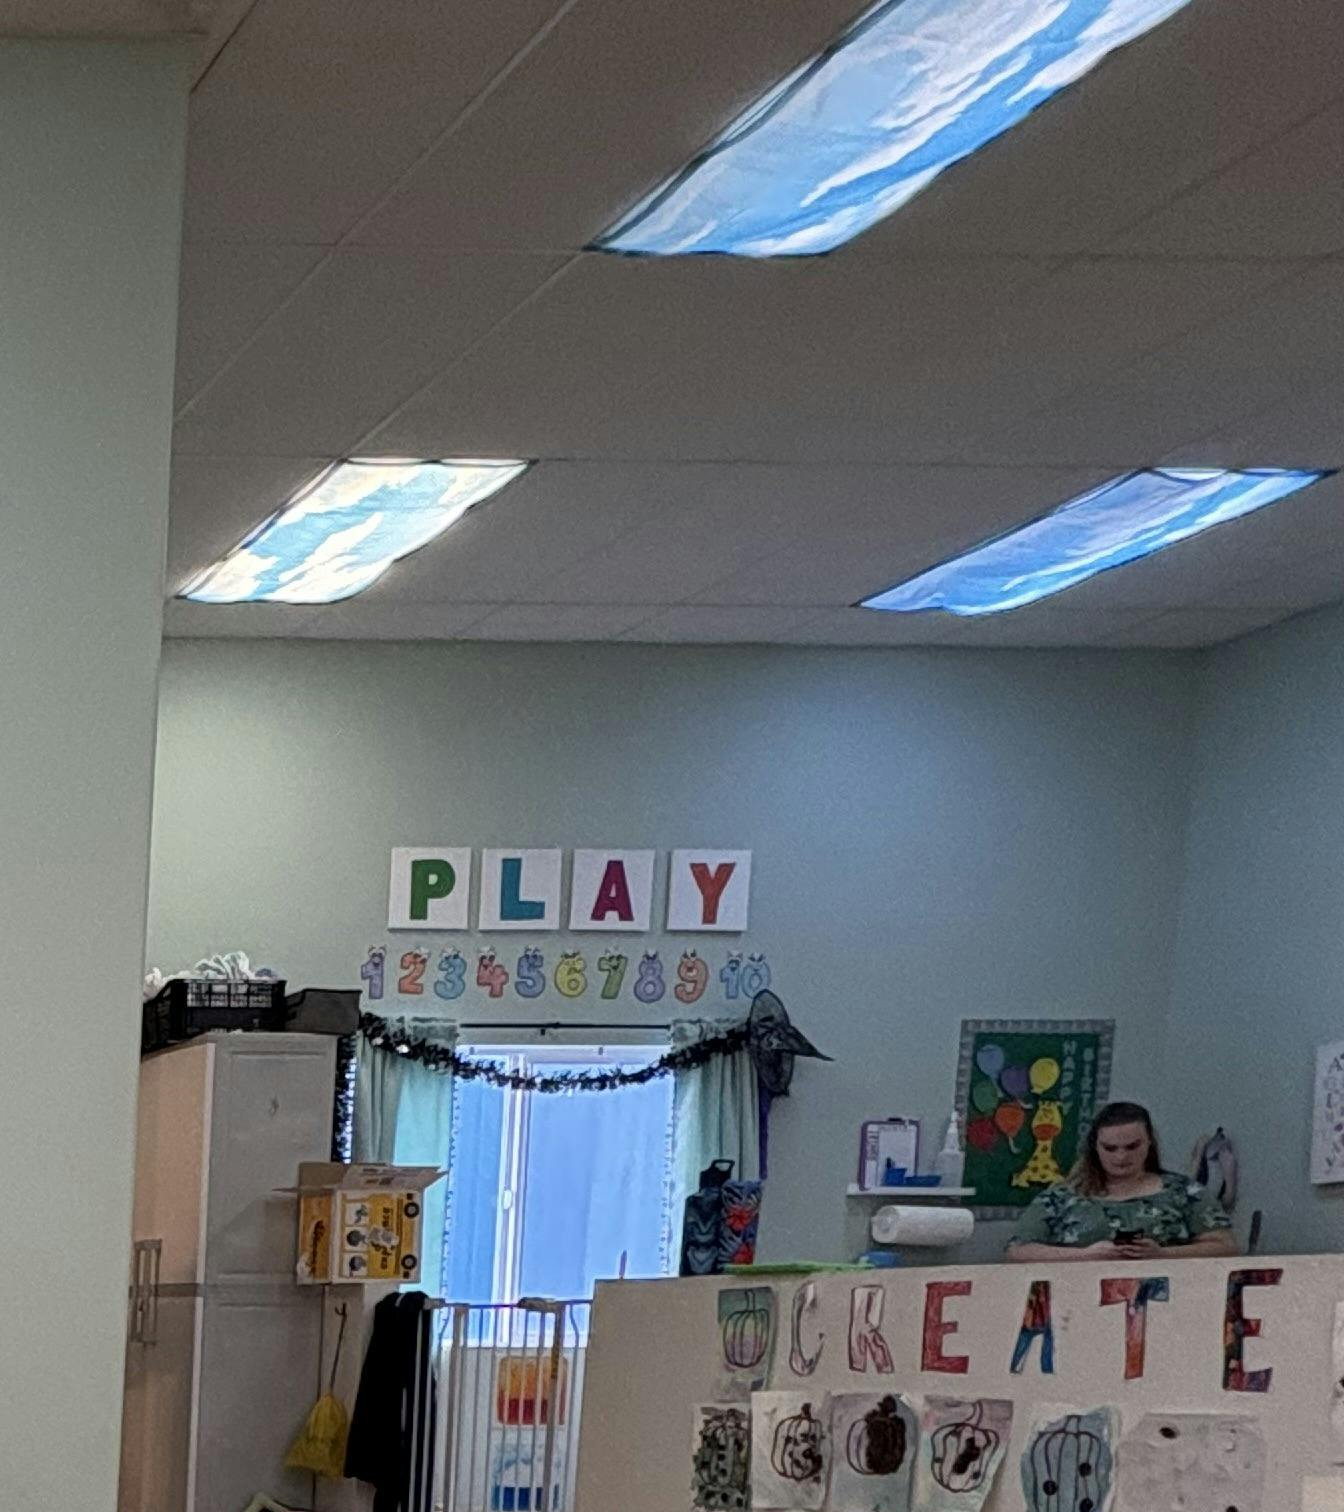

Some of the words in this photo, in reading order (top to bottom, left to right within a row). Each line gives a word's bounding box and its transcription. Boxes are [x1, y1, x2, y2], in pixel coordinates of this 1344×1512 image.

[409, 858, 737, 925] PLAY
[361, 949, 385, 1000] 1
[398, 950, 429, 995] 2
[434, 952, 467, 1001] 3
[477, 952, 509, 998] 4
[515, 951, 546, 998] 5
[554, 954, 588, 999] 6
[598, 954, 629, 1000] 7
[633, 954, 665, 1003] 8
[674, 954, 709, 1004] 9
[720, 955, 772, 1000] 10
[1060, 1039, 1078, 1116] HAPPY
[789, 1267, 1283, 1392] CREATE
